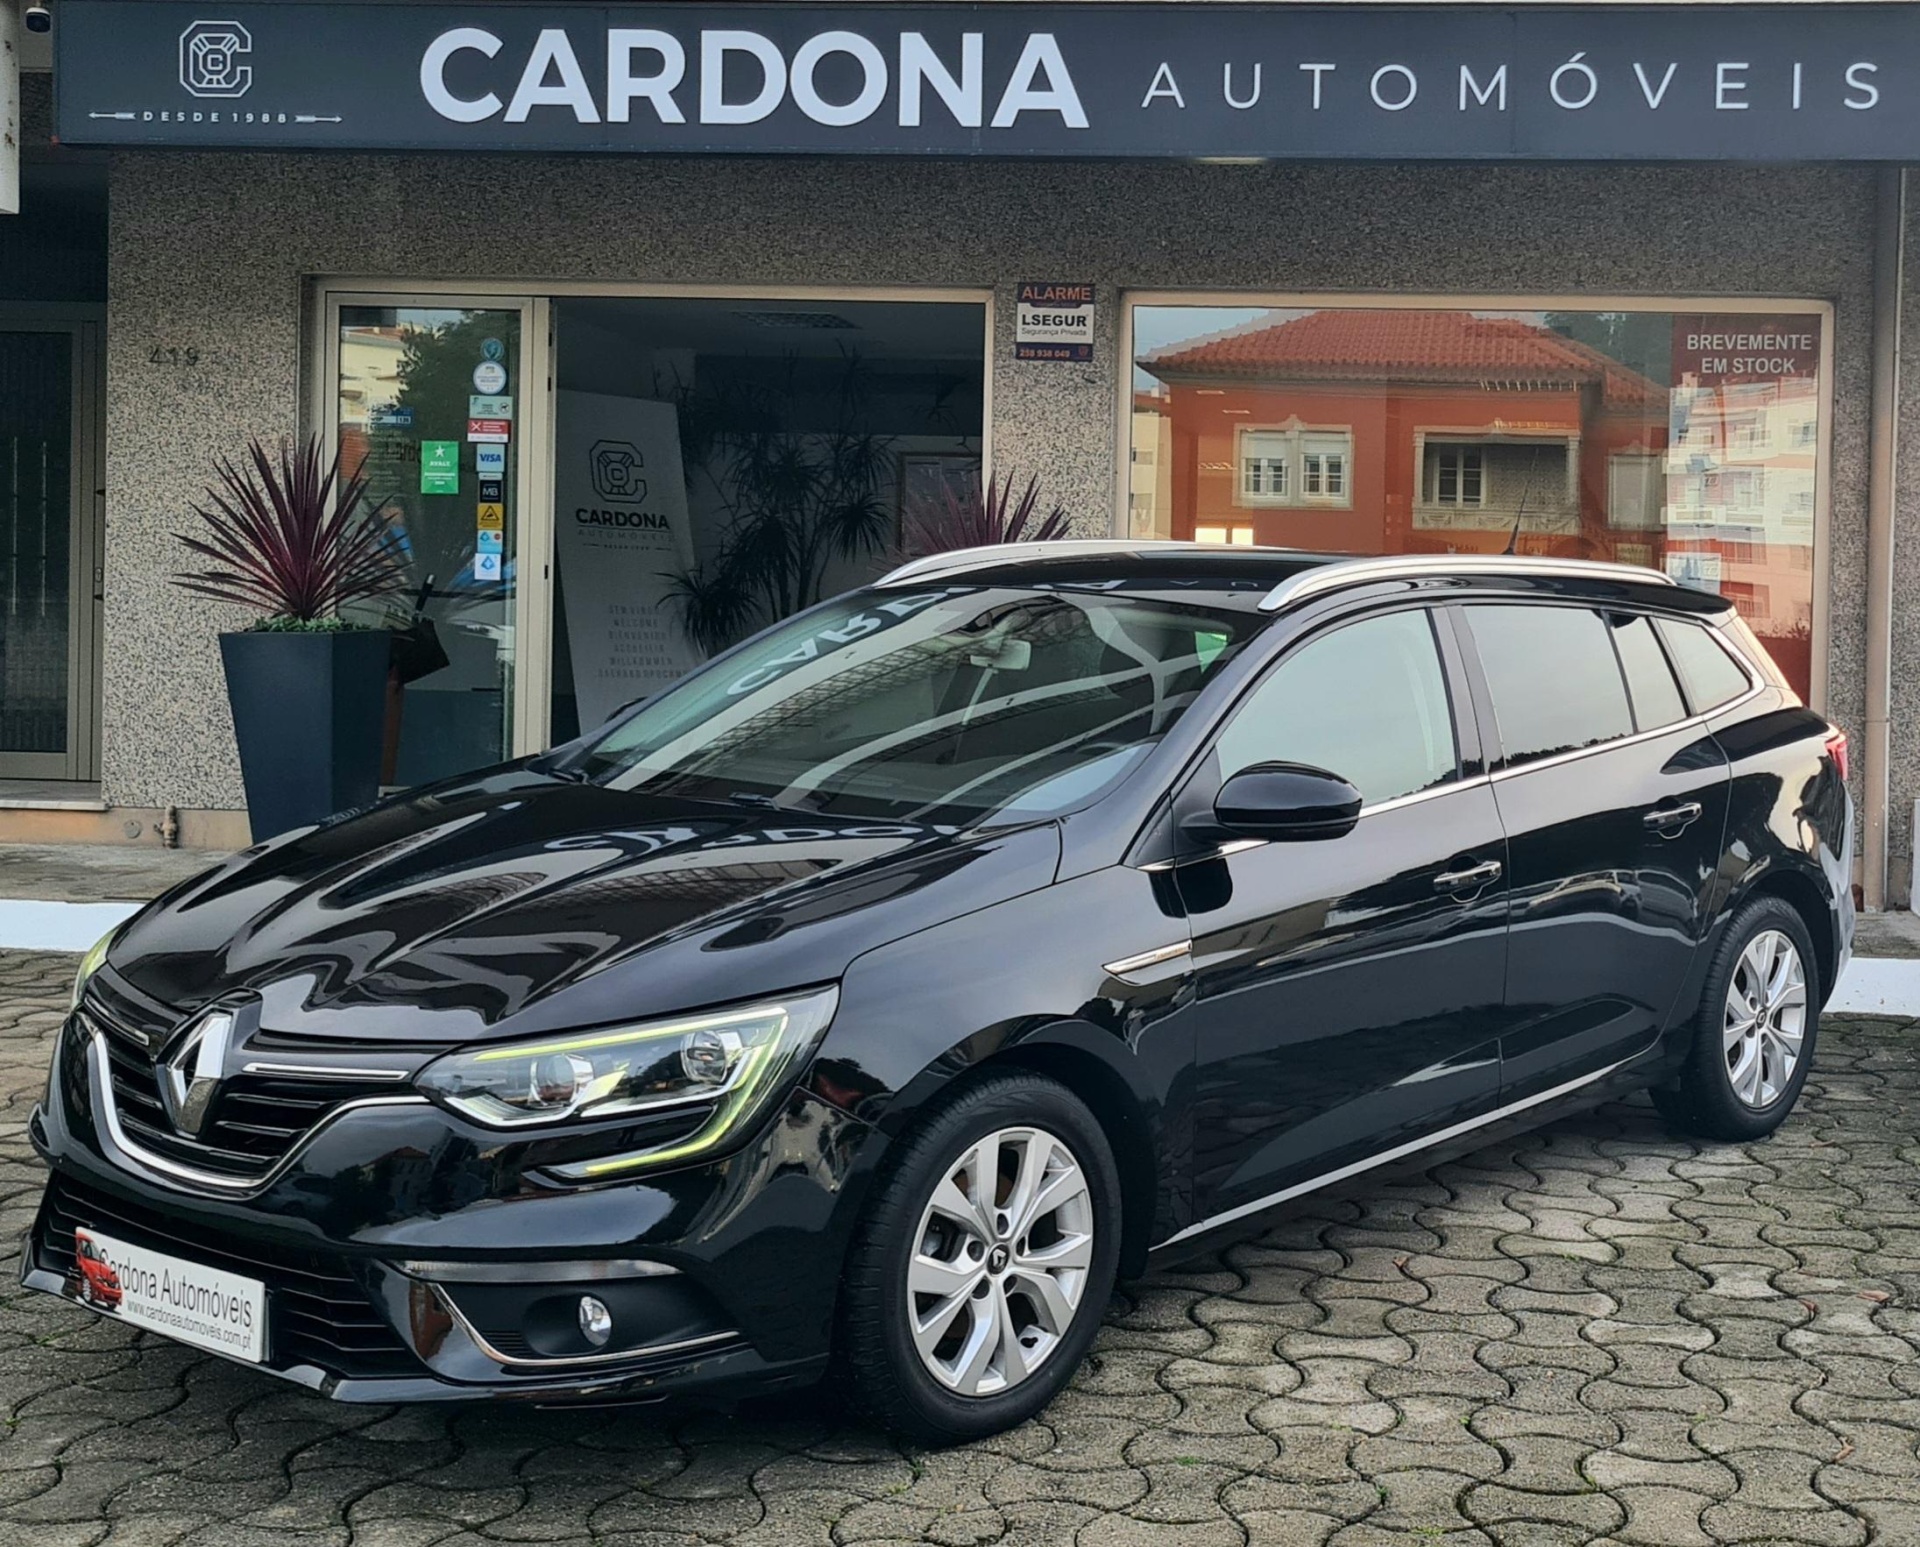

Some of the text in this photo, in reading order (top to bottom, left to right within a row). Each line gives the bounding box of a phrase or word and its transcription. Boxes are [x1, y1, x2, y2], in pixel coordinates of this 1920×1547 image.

[420, 28, 1881, 129] CARDONA AUTOMÓVEIS
[143, 111, 287, 124] DESDE 1988
[1022, 286, 1091, 301] ALARME
[1022, 314, 1087, 327] LSEGUR
[1686, 334, 1812, 350] BREVEMENTE
[1702, 358, 1796, 373] EM STOCK
[479, 453, 502, 462] VISA
[482, 487, 499, 496] MB
[575, 508, 671, 530] CARDONA
[160, 1268, 252, 1328] Automóveis
